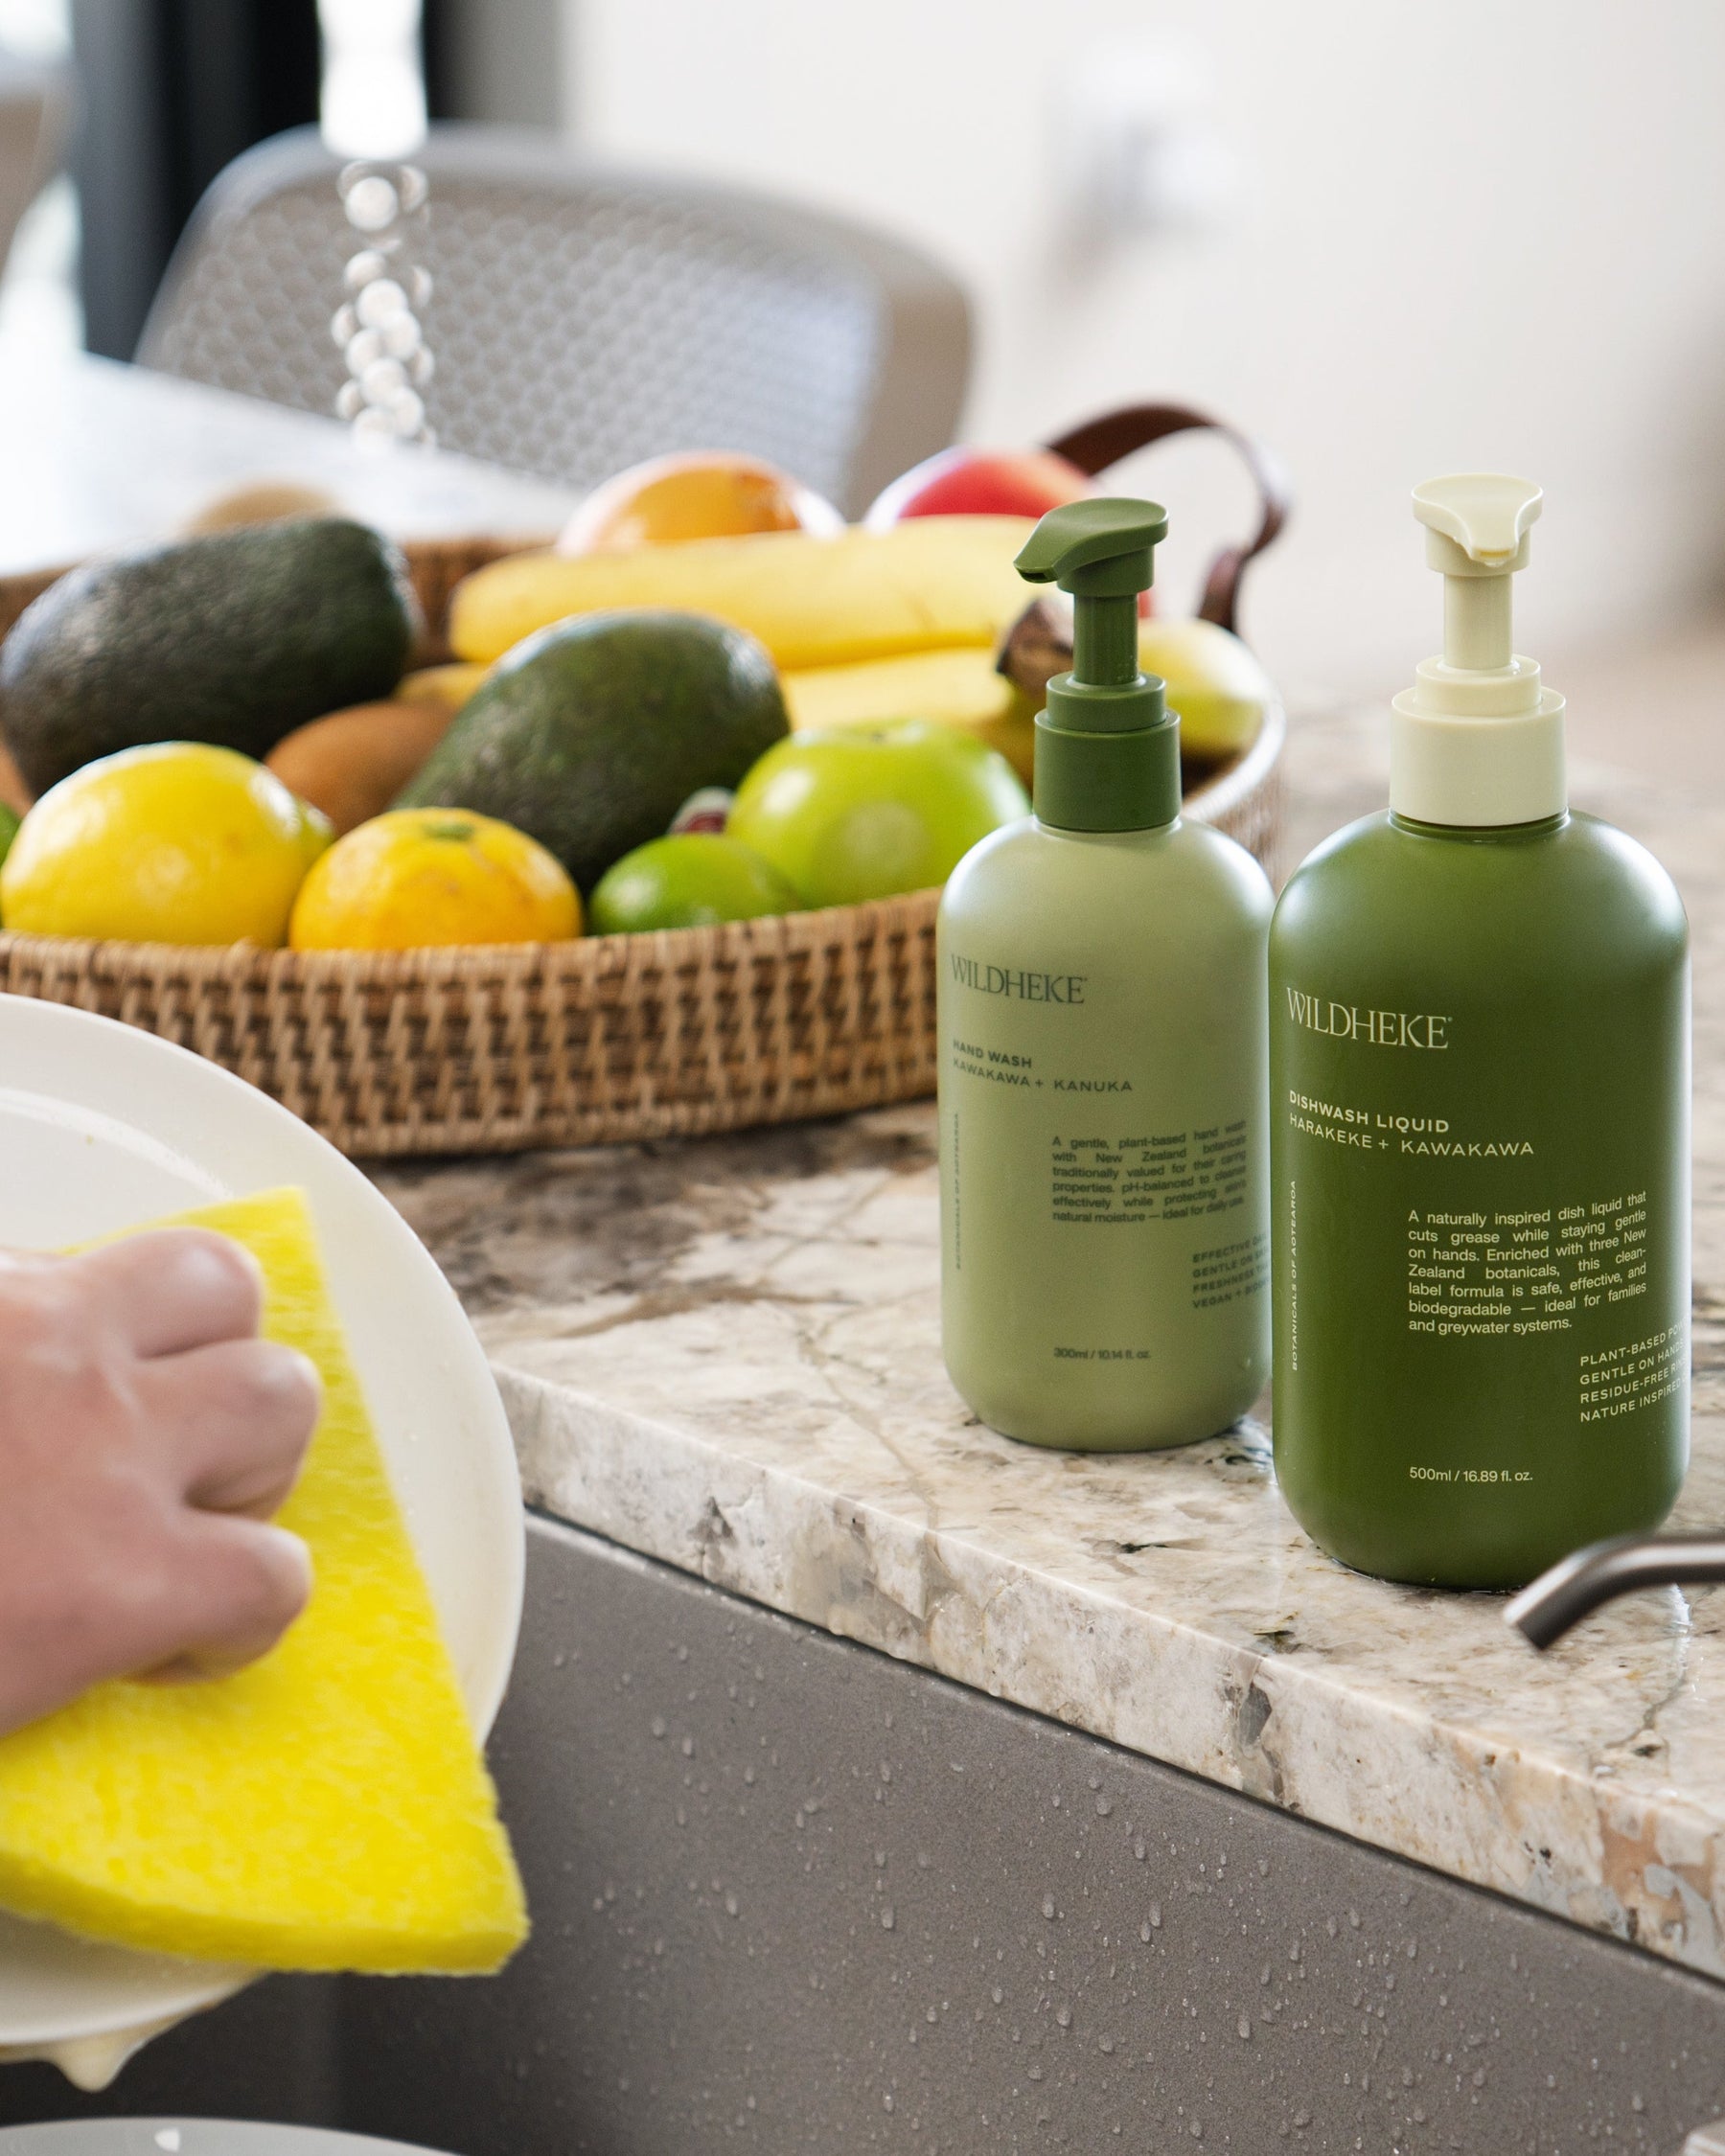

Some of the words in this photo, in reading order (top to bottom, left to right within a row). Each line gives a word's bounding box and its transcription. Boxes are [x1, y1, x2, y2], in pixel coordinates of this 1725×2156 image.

[951, 953, 1086, 1003] WILDHEKE
[1286, 987, 1449, 1049] WILDHEKE
[953, 1039, 983, 1059] HAND
[988, 1050, 1032, 1068] WASH
[953, 1058, 1030, 1087] KAWAKAWA
[1054, 1079, 1133, 1092] KANUKA
[1289, 1089, 1369, 1125] DISHWASH
[1376, 1113, 1450, 1134] LIQUID
[1052, 1136, 1061, 1147] A
[1070, 1136, 1110, 1150] gentle,
[1119, 1133, 1186, 1149] plant-based
[1194, 1127, 1218, 1140] hand
[1289, 1112, 1372, 1149] HARAKEKE
[1378, 1138, 1389, 1150] +
[1401, 1139, 1534, 1157] KAWAKAWA
[1052, 1152, 1076, 1162] with
[1095, 1153, 1122, 1163] New
[1141, 1149, 1186, 1162] Zealand
[1052, 1166, 1119, 1180] traditionally
[1126, 1165, 1164, 1178] valued
[1172, 1163, 1186, 1174] for
[1194, 1158, 1214, 1171] their
[1052, 1182, 1116, 1194] properties.
[1121, 1178, 1194, 1194] pH-balanced
[1200, 1174, 1209, 1184] to
[1052, 1198, 1111, 1210] effectively
[1123, 1197, 1154, 1207] while
[1164, 1189, 1216, 1206] protecting
[1052, 1211, 1092, 1222] natural
[1094, 1212, 1145, 1222] moisture
[1162, 1206, 1188, 1220] ideal
[1190, 1204, 1205, 1216] for
[1408, 1210, 1419, 1223] A
[1427, 1211, 1486, 1227] naturally
[1495, 1209, 1551, 1227] inspired
[1558, 1205, 1585, 1221] dish
[1592, 1198, 1622, 1216] liquid
[1627, 1190, 1646, 1205] that
[1408, 1229, 1438, 1242] cuts
[1451, 1232, 1500, 1246] grease
[1513, 1229, 1550, 1243] while
[1561, 1221, 1605, 1239] staying
[1615, 1209, 1646, 1230] gentle
[1192, 1240, 1251, 1263] EFFECTIVE
[1408, 1249, 1426, 1259] on
[1433, 1248, 1481, 1262] hands.
[1486, 1247, 1550, 1262] Enriched
[1555, 1243, 1583, 1257] with
[1589, 1236, 1620, 1252] three
[1624, 1228, 1646, 1245] New
[1192, 1259, 1237, 1278] GENTLE
[1291, 1259, 1297, 1279] OF
[1408, 1264, 1465, 1279] Zealand
[1486, 1264, 1560, 1279] botanicals,
[1577, 1258, 1600, 1273] this
[1615, 1248, 1646, 1265] clean-
[1409, 1282, 1441, 1296] label
[1450, 1283, 1504, 1297] formula
[1512, 1284, 1524, 1296] is
[1530, 1281, 1563, 1296] safe,
[1570, 1273, 1622, 1292] effective,
[1627, 1262, 1646, 1279] and
[1192, 1293, 1232, 1308] VEGAN
[1409, 1300, 1511, 1318] biodegradable
[1545, 1297, 1576, 1313] ideal
[1584, 1294, 1601, 1308] for
[1608, 1281, 1646, 1303] families
[1409, 1319, 1436, 1332] and
[1438, 1321, 1509, 1336] greywater
[1513, 1318, 1573, 1335] systems.
[1580, 1332, 1666, 1366] PLANT-BASED
[1579, 1364, 1635, 1386] GENTLE
[1639, 1356, 1655, 1370] ON
[1580, 1367, 1668, 1405] RESIDUE-FREE
[1580, 1400, 1636, 1423] NATURE
[1640, 1378, 1681, 1408] INSPIRED
[1409, 1467, 1451, 1481] 500ml
[1454, 1470, 1460, 1481] /
[1463, 1470, 1498, 1482] 16.89
[1501, 1470, 1512, 1481] fl.
[1514, 1472, 1533, 1481] oz.
